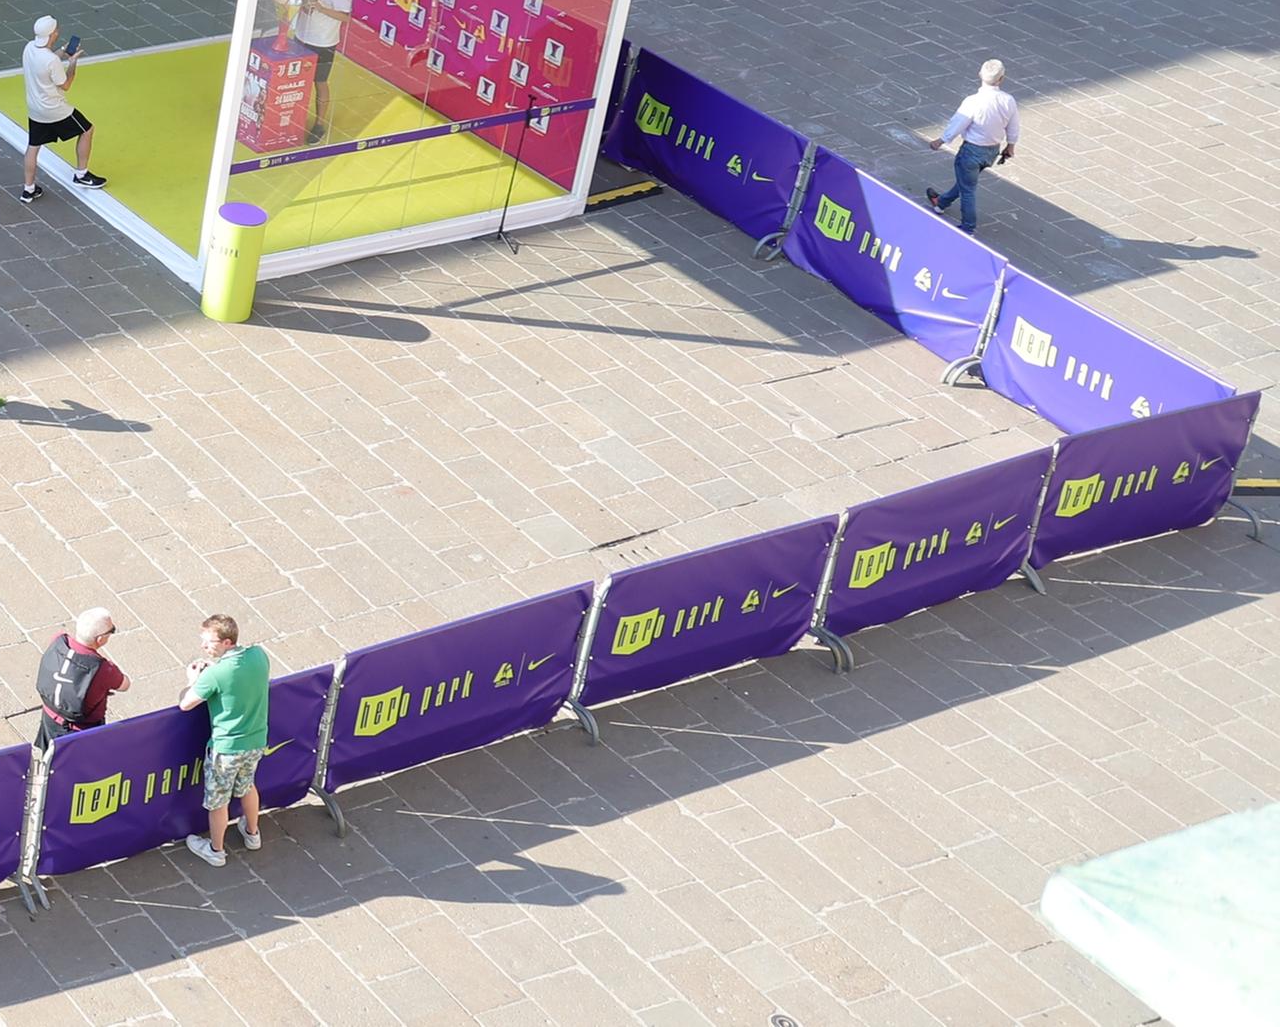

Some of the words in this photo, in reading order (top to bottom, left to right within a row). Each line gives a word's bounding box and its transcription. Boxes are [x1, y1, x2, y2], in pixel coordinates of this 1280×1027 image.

[639, 98, 674, 136] hero
[675, 124, 715, 161] park
[818, 200, 856, 242] hero
[858, 230, 903, 273] park
[1016, 324, 1058, 368] hero
[1063, 355, 1114, 401] park
[1060, 480, 1105, 511] hero
[1110, 465, 1158, 503] park
[854, 547, 897, 582] hero
[903, 527, 950, 570] park
[617, 614, 666, 648] hero
[672, 595, 724, 638] park
[360, 692, 411, 730] hero
[420, 670, 474, 716] park
[76, 779, 131, 817] hero
[144, 757, 203, 804] park
